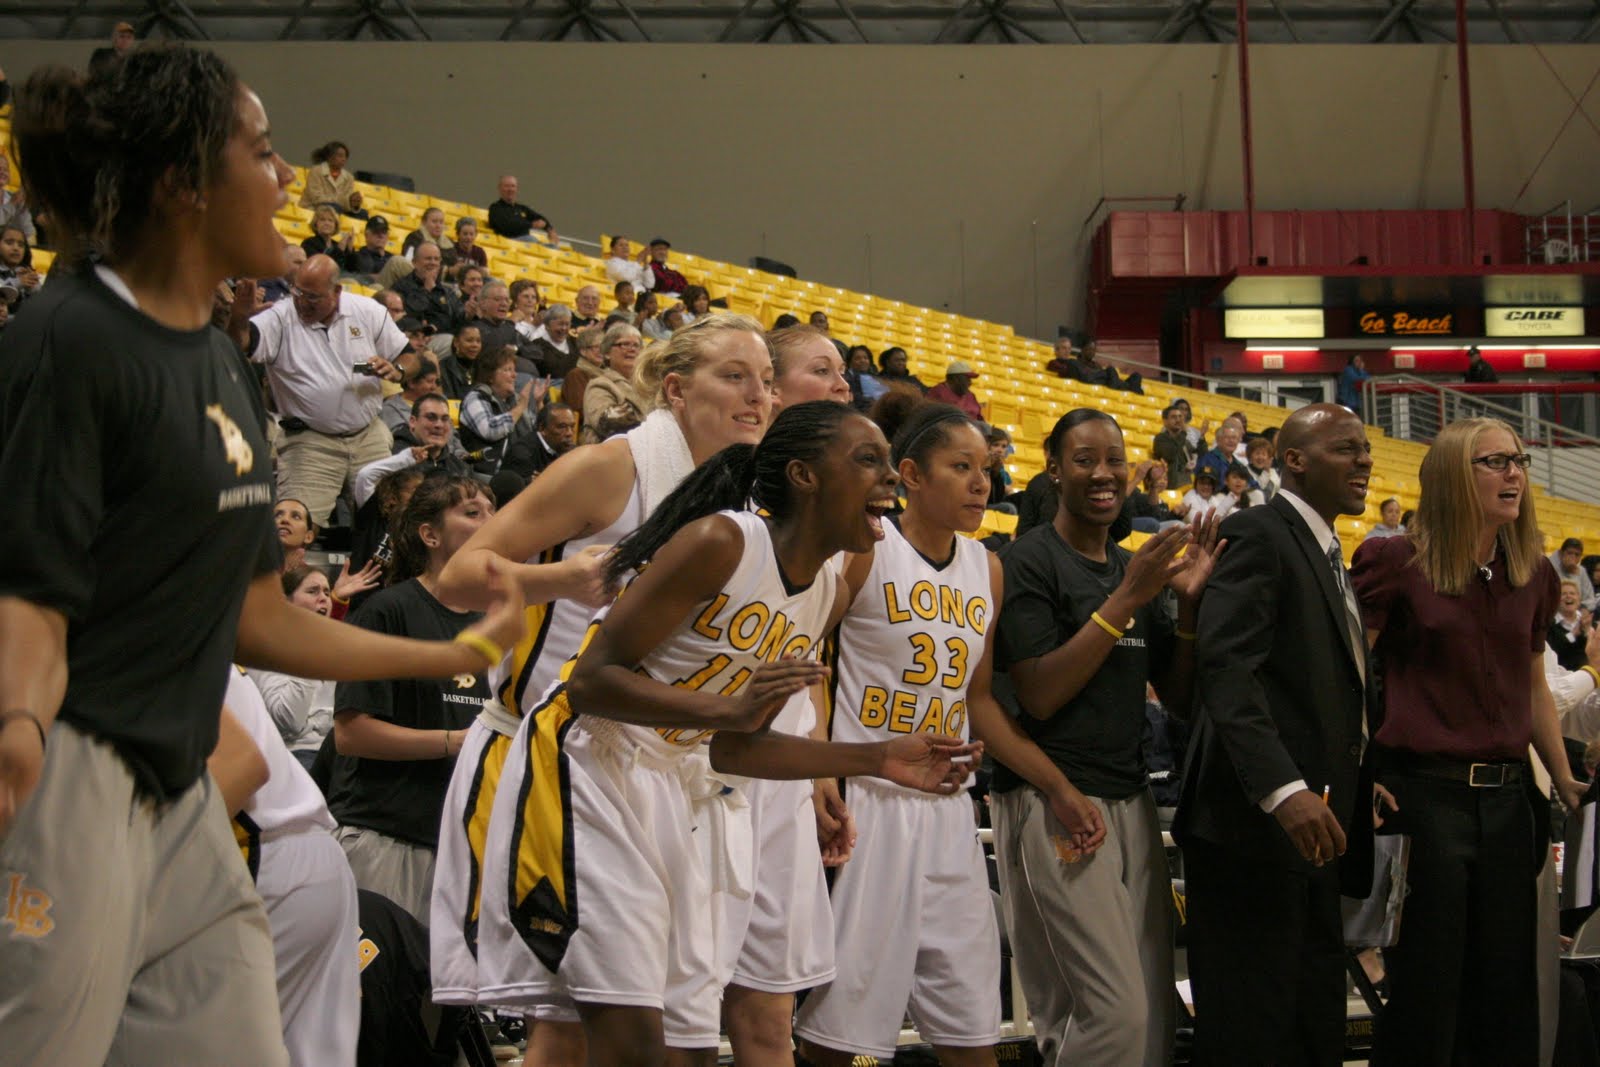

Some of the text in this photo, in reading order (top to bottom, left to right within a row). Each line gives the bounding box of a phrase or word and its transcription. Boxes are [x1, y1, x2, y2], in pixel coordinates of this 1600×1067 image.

[1360, 311, 1453, 335] Go Beach
[1504, 310, 1567, 321] CABE
[1517, 322, 1552, 331] TOYOTA
[883, 579, 987, 636] LONG
[902, 632, 969, 690] 33
[859, 685, 967, 738] BEAC
